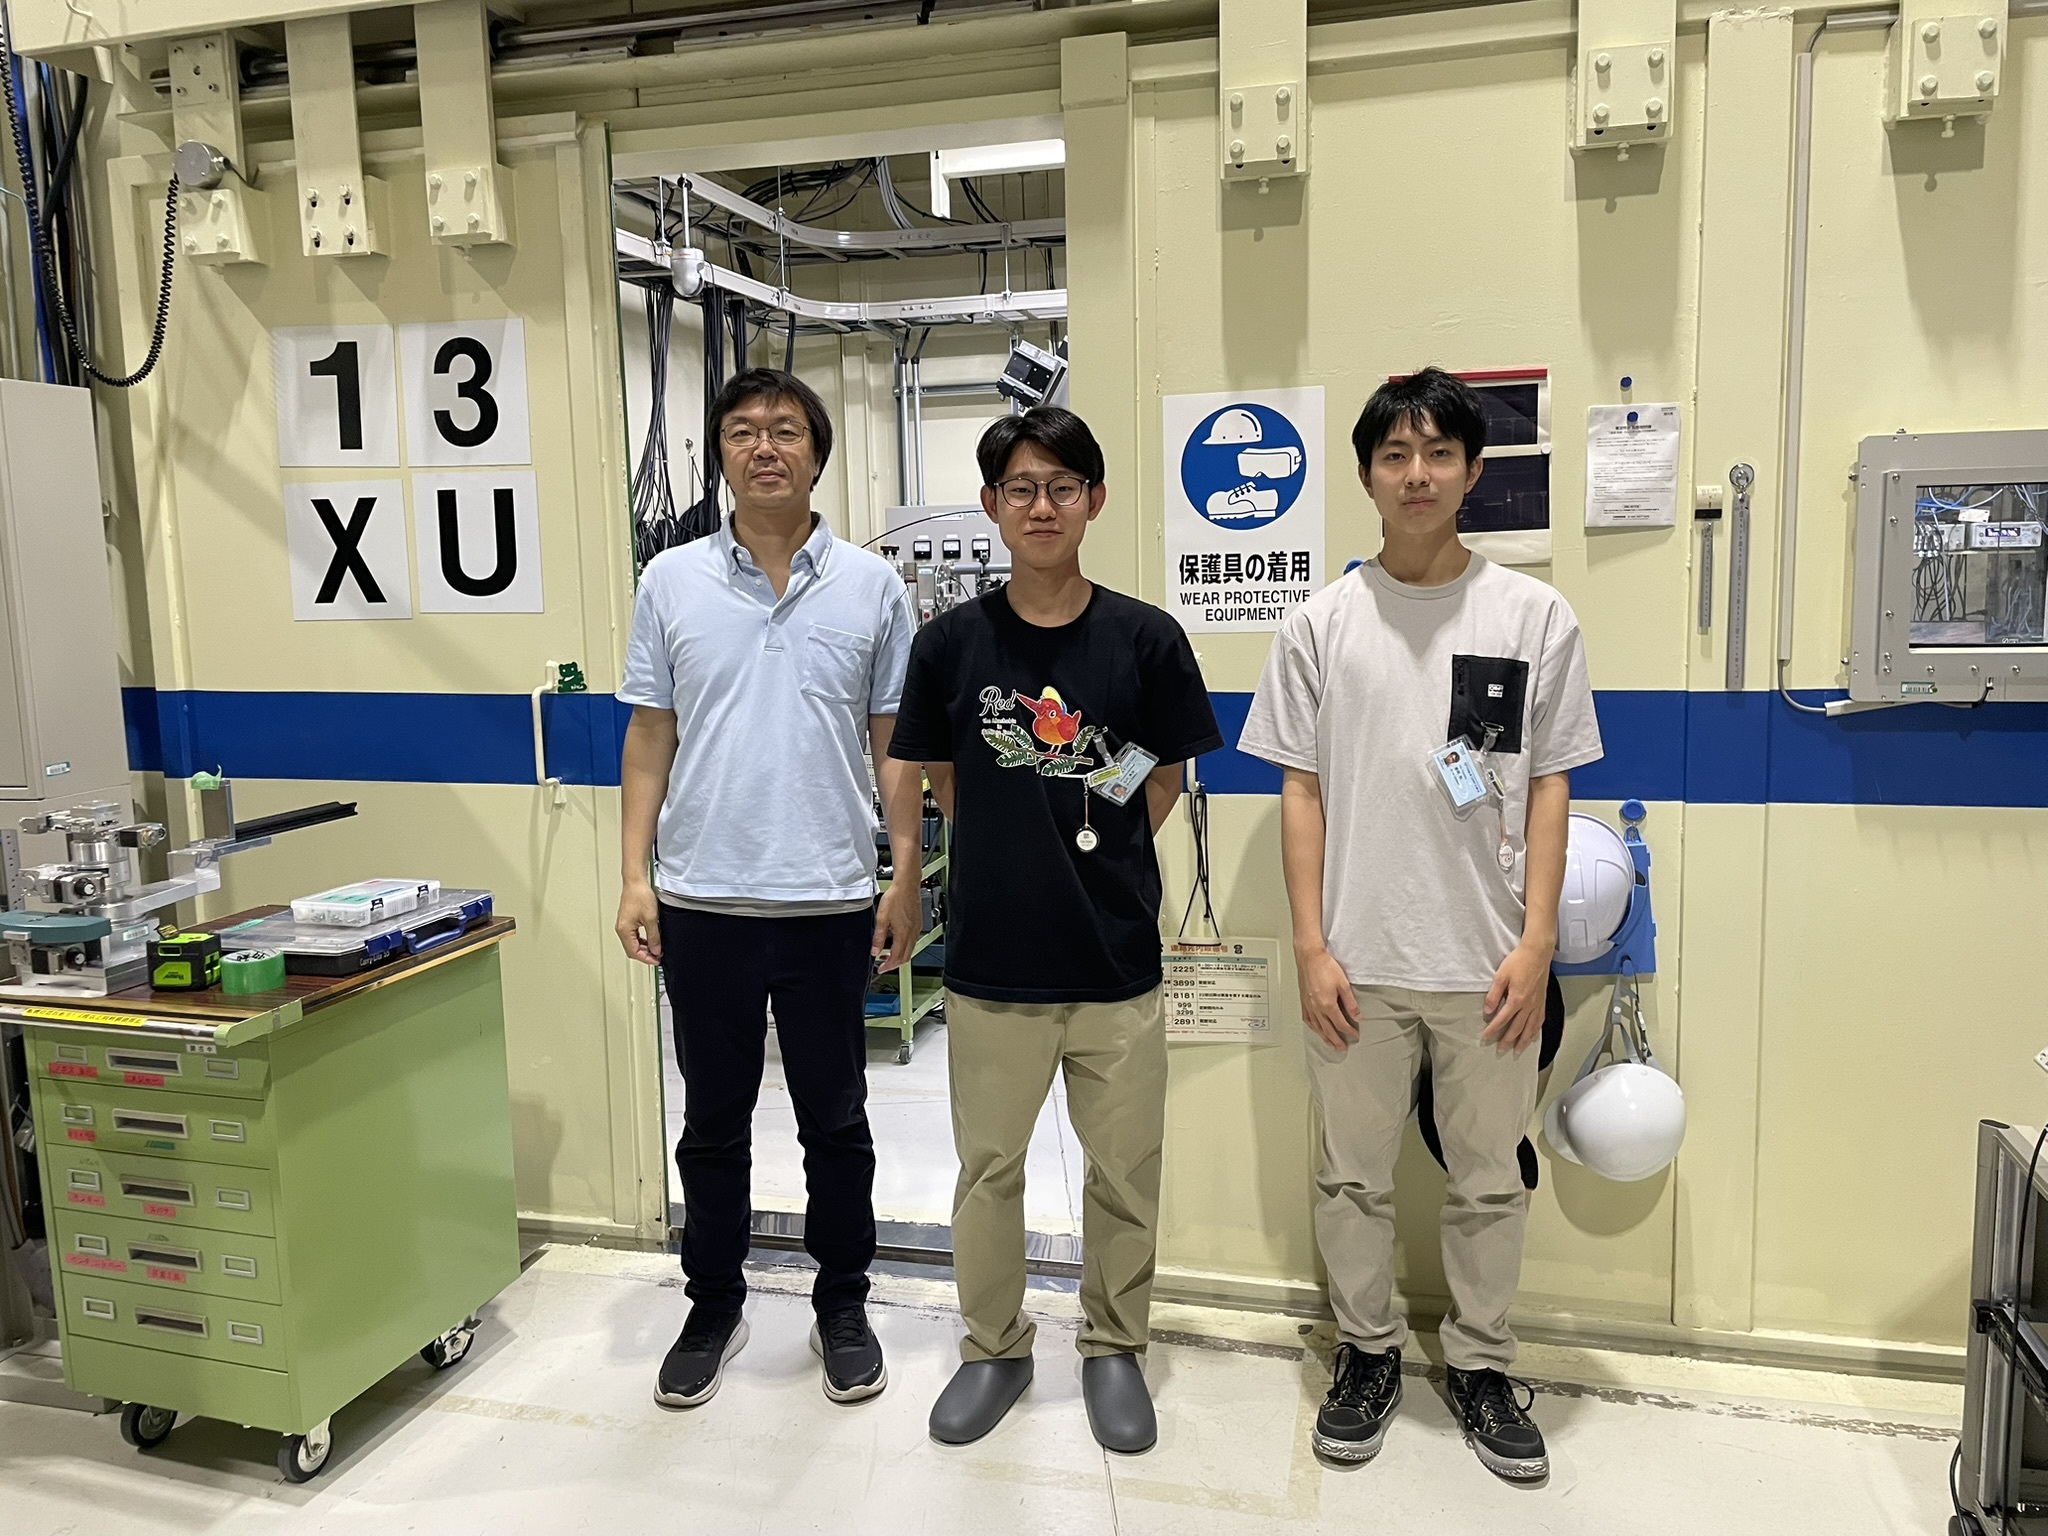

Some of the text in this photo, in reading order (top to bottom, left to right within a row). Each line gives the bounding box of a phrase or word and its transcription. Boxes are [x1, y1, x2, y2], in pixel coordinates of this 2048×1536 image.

[1179, 551, 1310, 585] 保護具の着用
[1180, 589, 1311, 605] WEAR PROTECTIVE
[1205, 607, 1285, 622] EQUIPMENT
[979, 686, 1016, 716] Red
